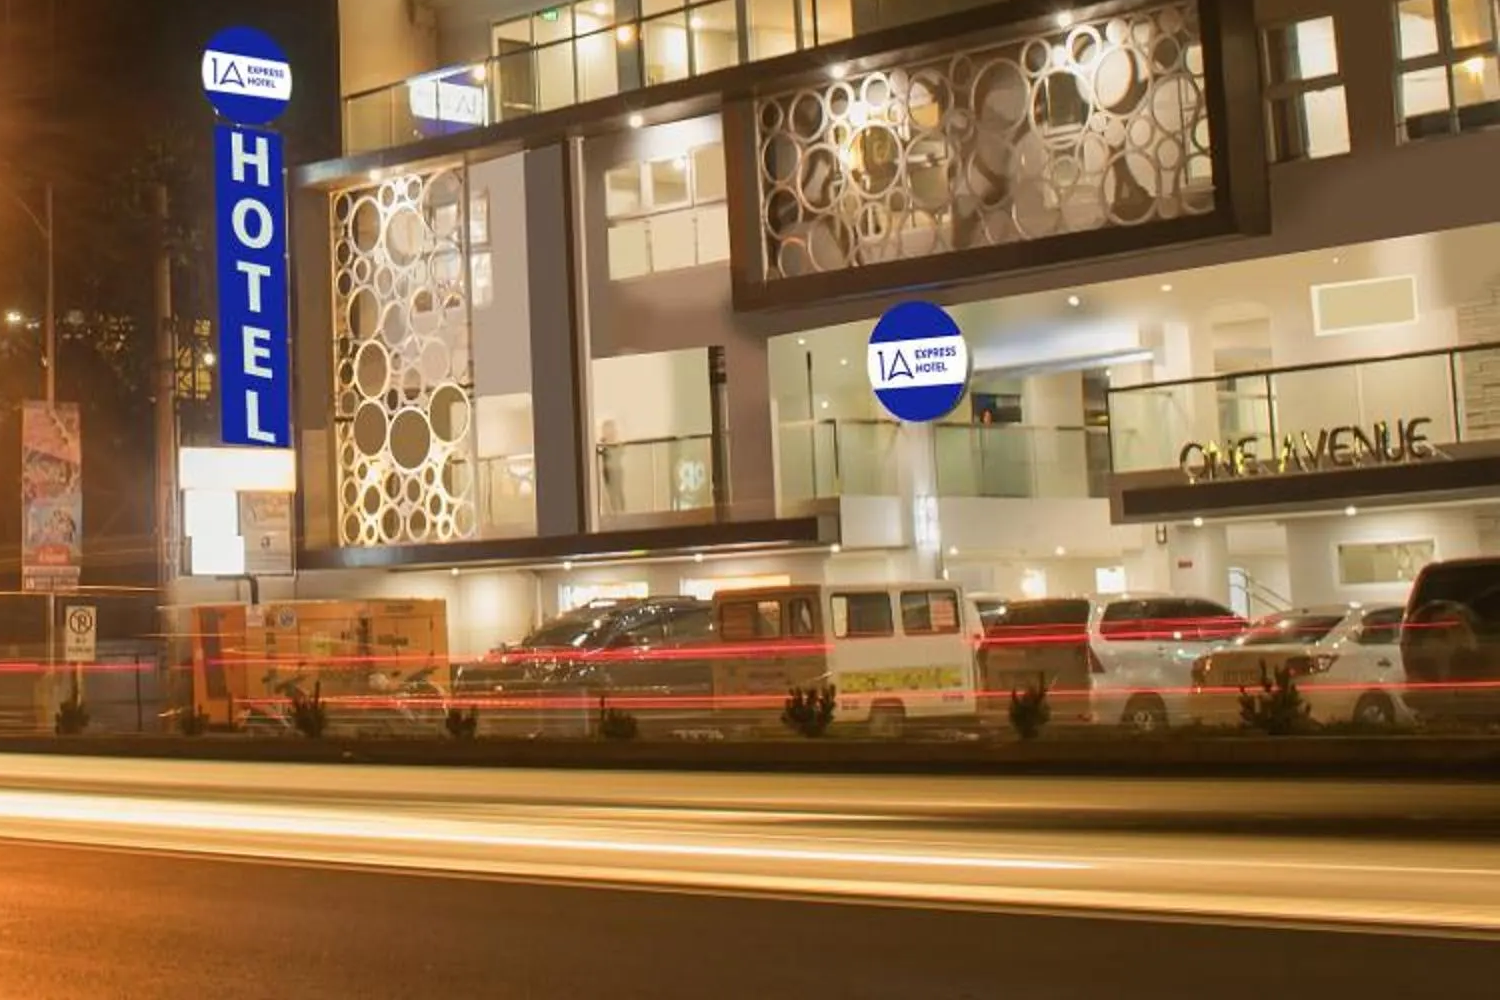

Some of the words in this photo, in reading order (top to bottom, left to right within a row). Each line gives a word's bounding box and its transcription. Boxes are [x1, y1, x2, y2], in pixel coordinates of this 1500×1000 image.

[247, 65, 284, 79] EXPRESS
[247, 76, 277, 89] HOTEL
[231, 131, 276, 444] HOTEL
[914, 345, 958, 360] EXPRESS
[915, 361, 949, 374] HOTEL
[1179, 435, 1258, 484] ONE
[1278, 416, 1432, 474] AVENUE
